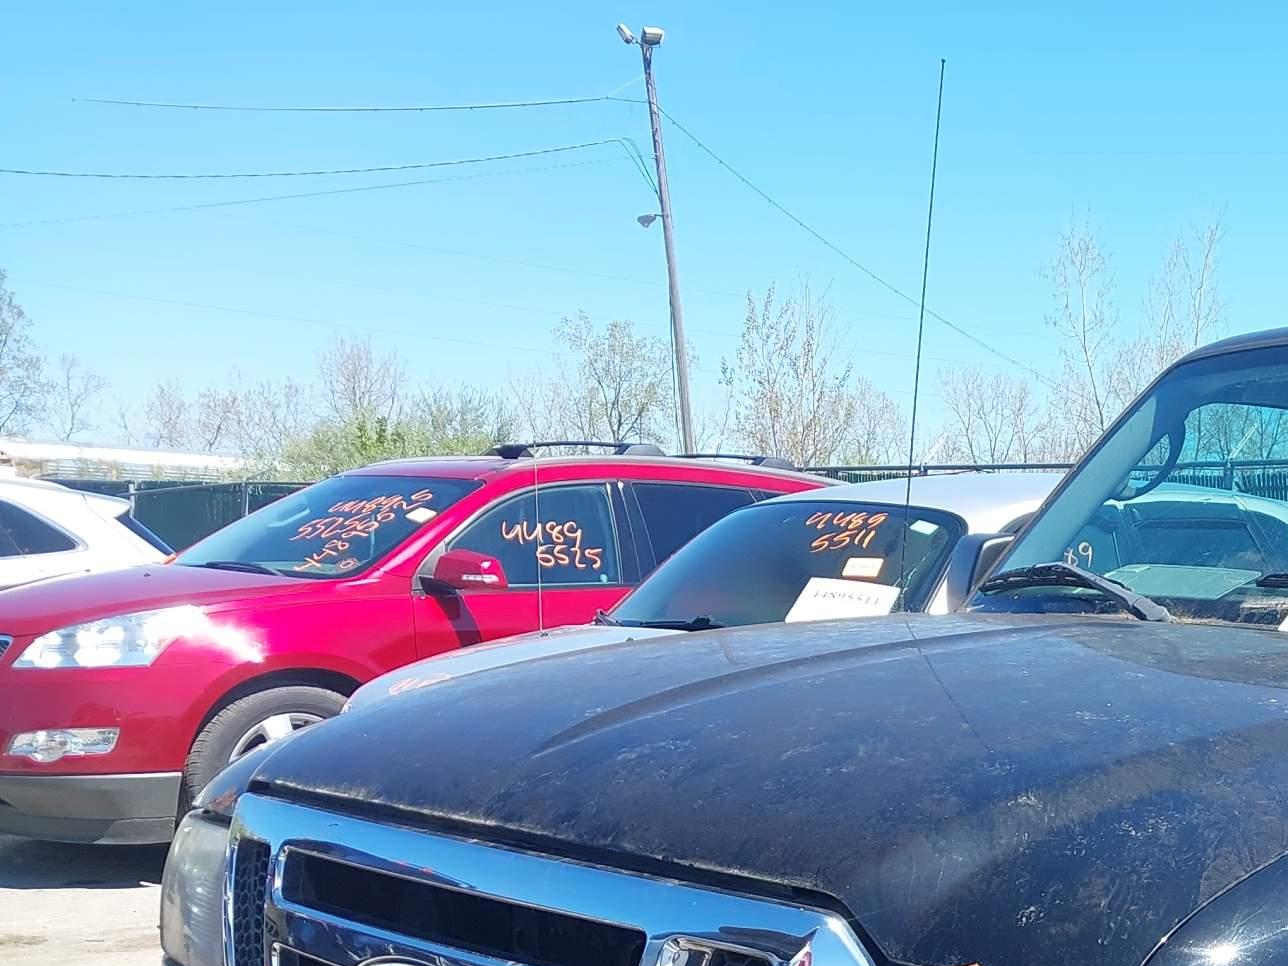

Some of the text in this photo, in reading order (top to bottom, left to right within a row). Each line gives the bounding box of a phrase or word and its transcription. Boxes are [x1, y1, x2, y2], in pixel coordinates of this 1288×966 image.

[805, 511, 889, 530] 4489
[502, 520, 583, 548] 4489
[809, 528, 876, 553] 5511
[536, 544, 603, 569] 5525
